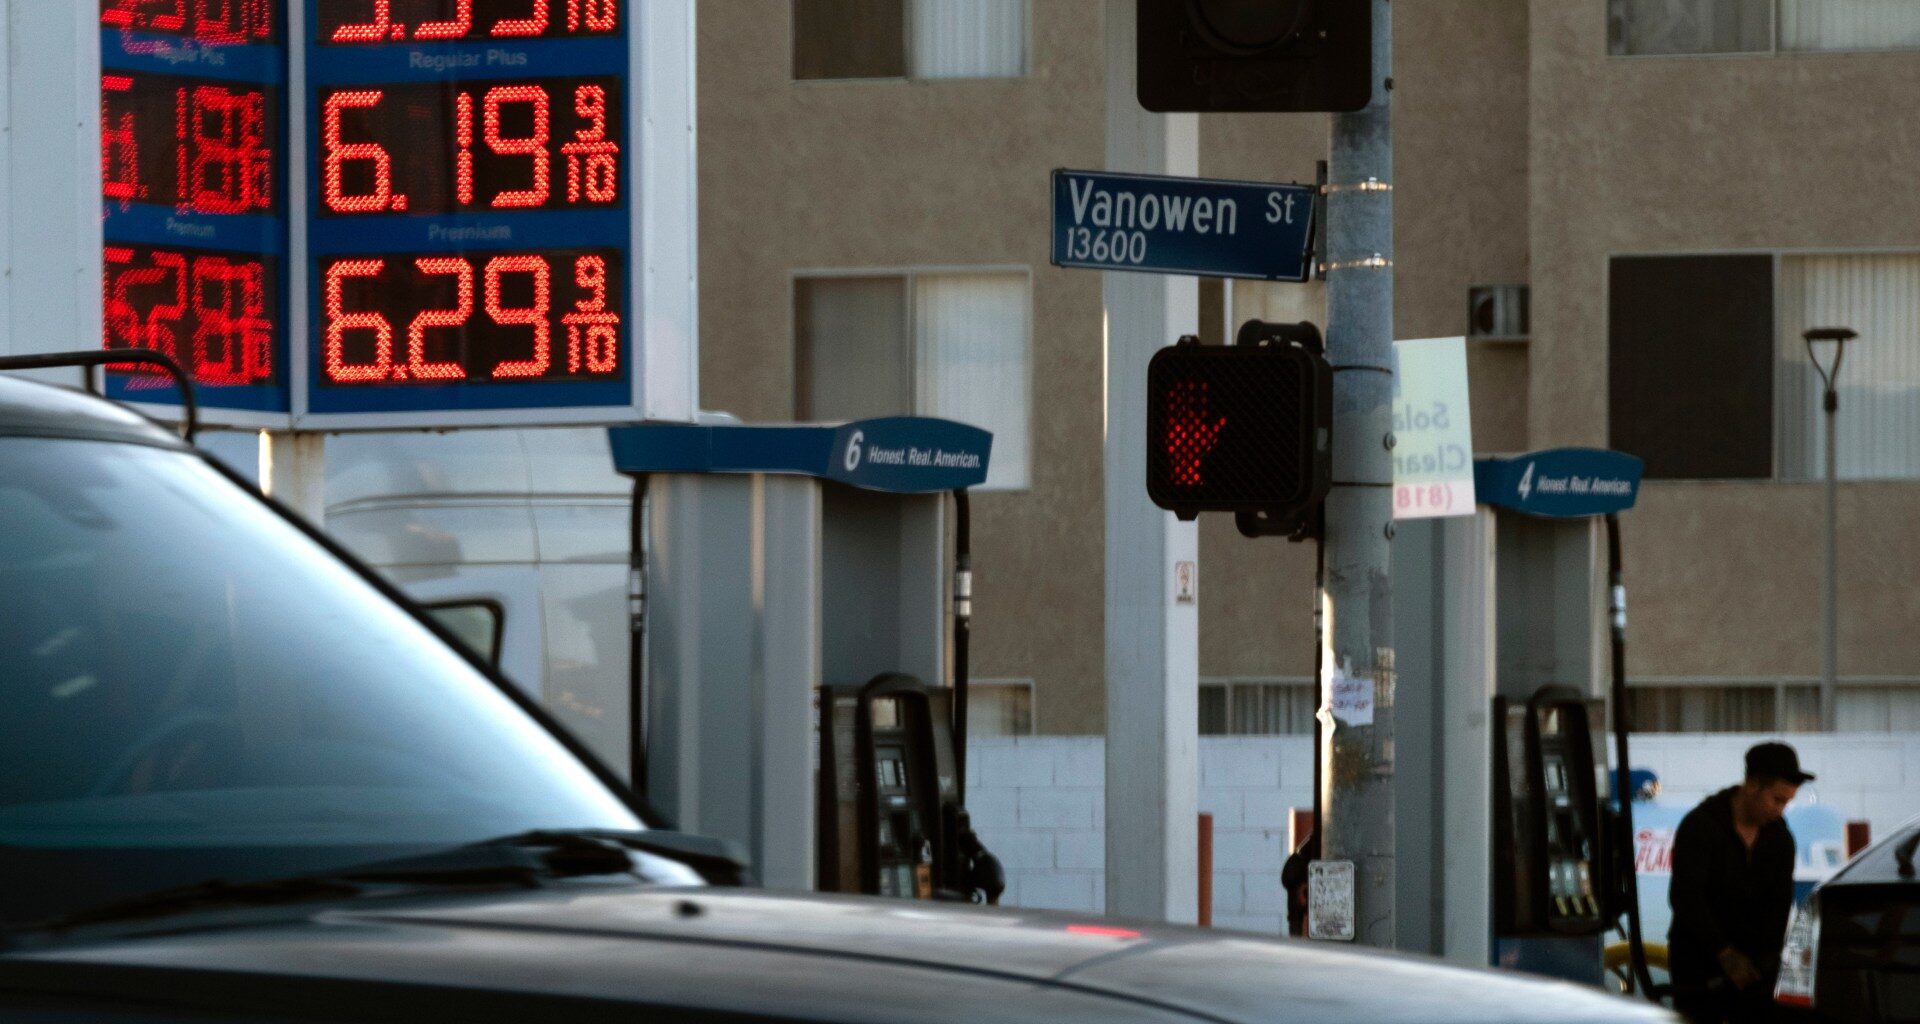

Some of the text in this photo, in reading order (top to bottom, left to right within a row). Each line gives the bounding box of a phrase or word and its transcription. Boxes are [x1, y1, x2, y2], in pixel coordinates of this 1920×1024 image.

[409, 48, 527, 72] Regular Plus
[325, 86, 549, 212] 6.19
[1069, 178, 1295, 236] Vanowen St
[428, 223, 512, 241] Premium
[1067, 226, 1147, 264] 13600
[326, 255, 550, 383] 6.29
[844, 431, 864, 472] 6
[868, 445, 981, 468] Honest. Real. American.
[1518, 461, 1535, 500] 4
